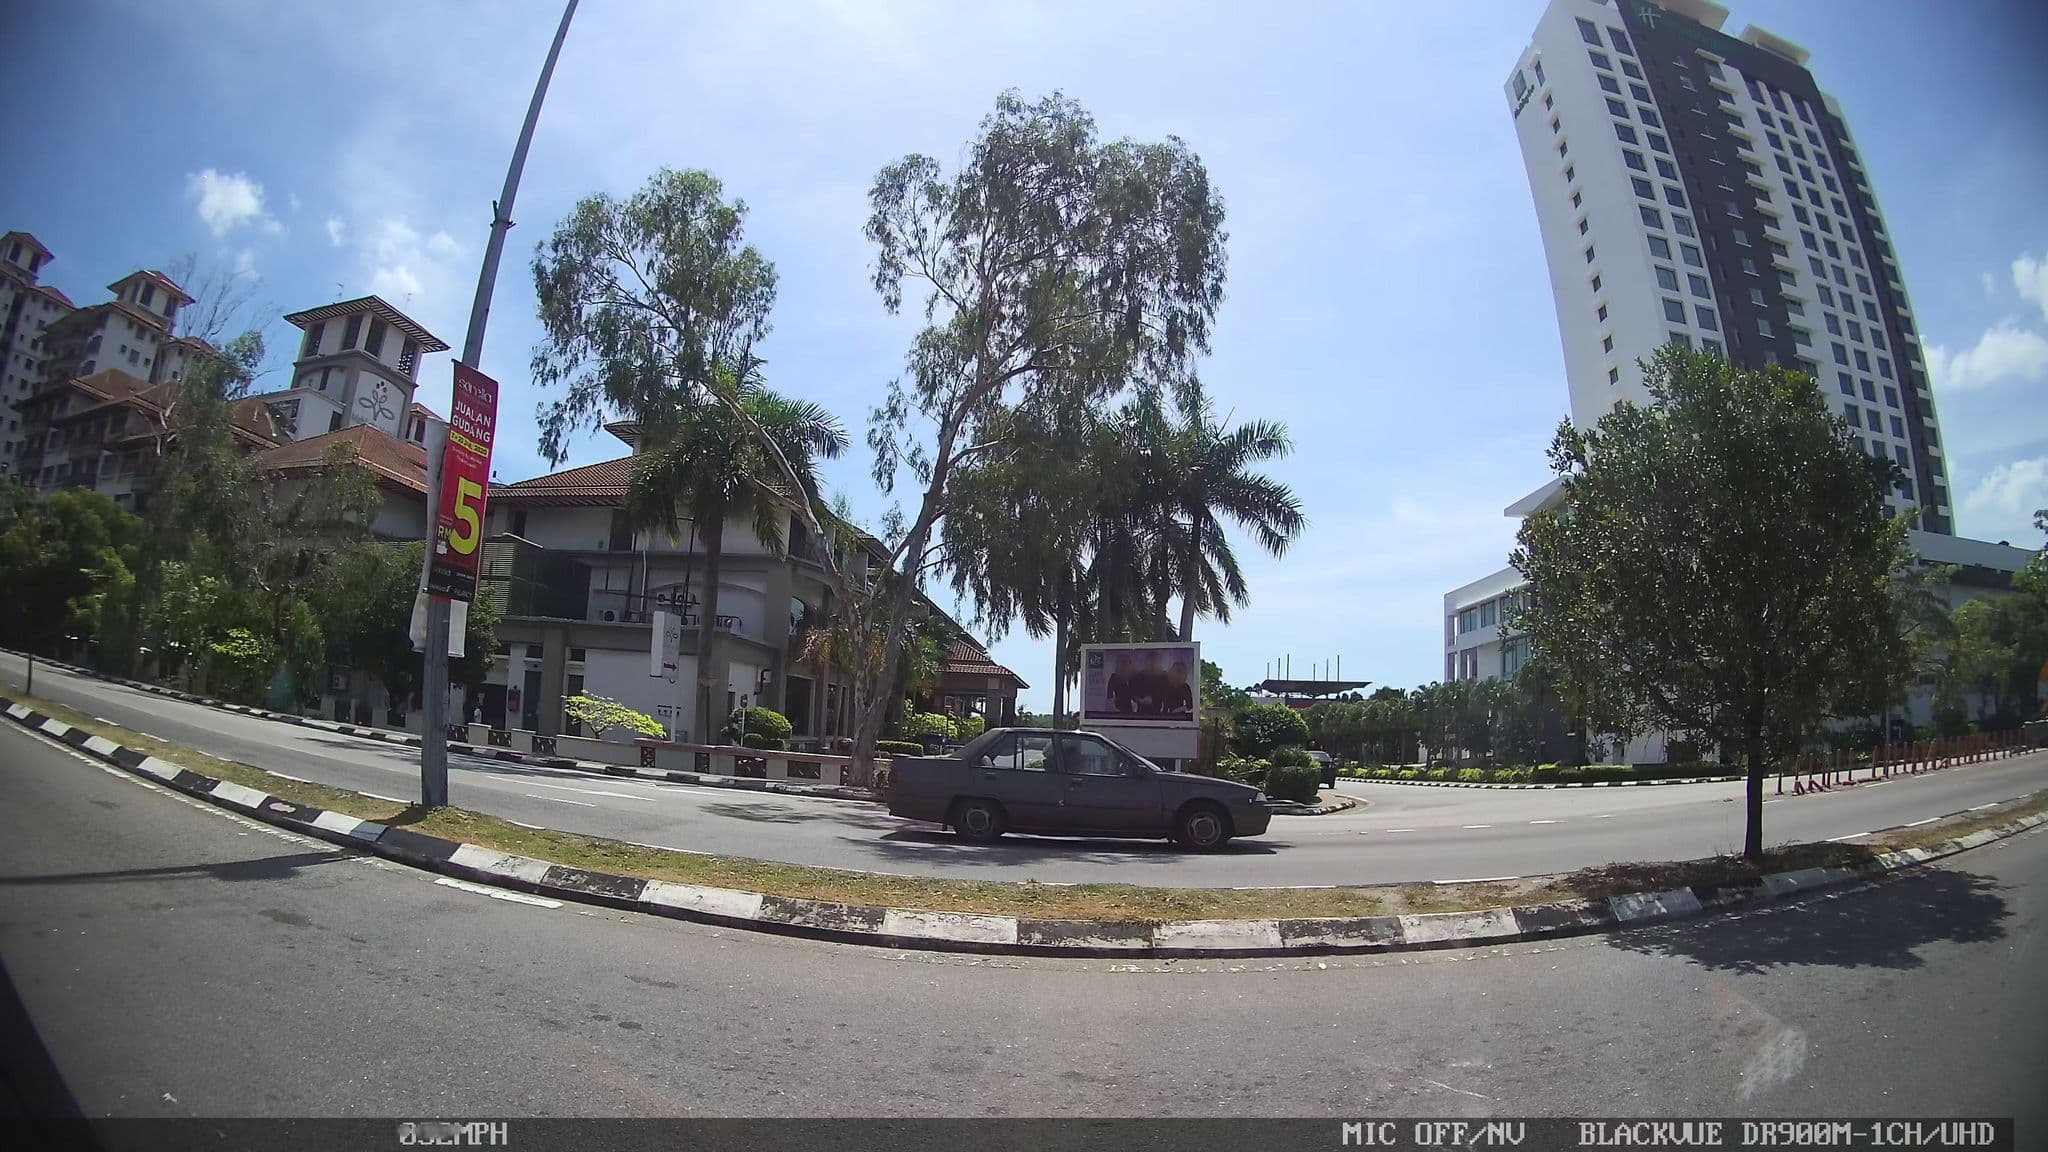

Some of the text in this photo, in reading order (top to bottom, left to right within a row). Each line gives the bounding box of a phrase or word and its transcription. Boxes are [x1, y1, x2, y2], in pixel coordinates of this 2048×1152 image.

[455, 401, 491, 427] JUALAN
[452, 415, 491, 443] GUDANG
[437, 476, 481, 554] RM 5
